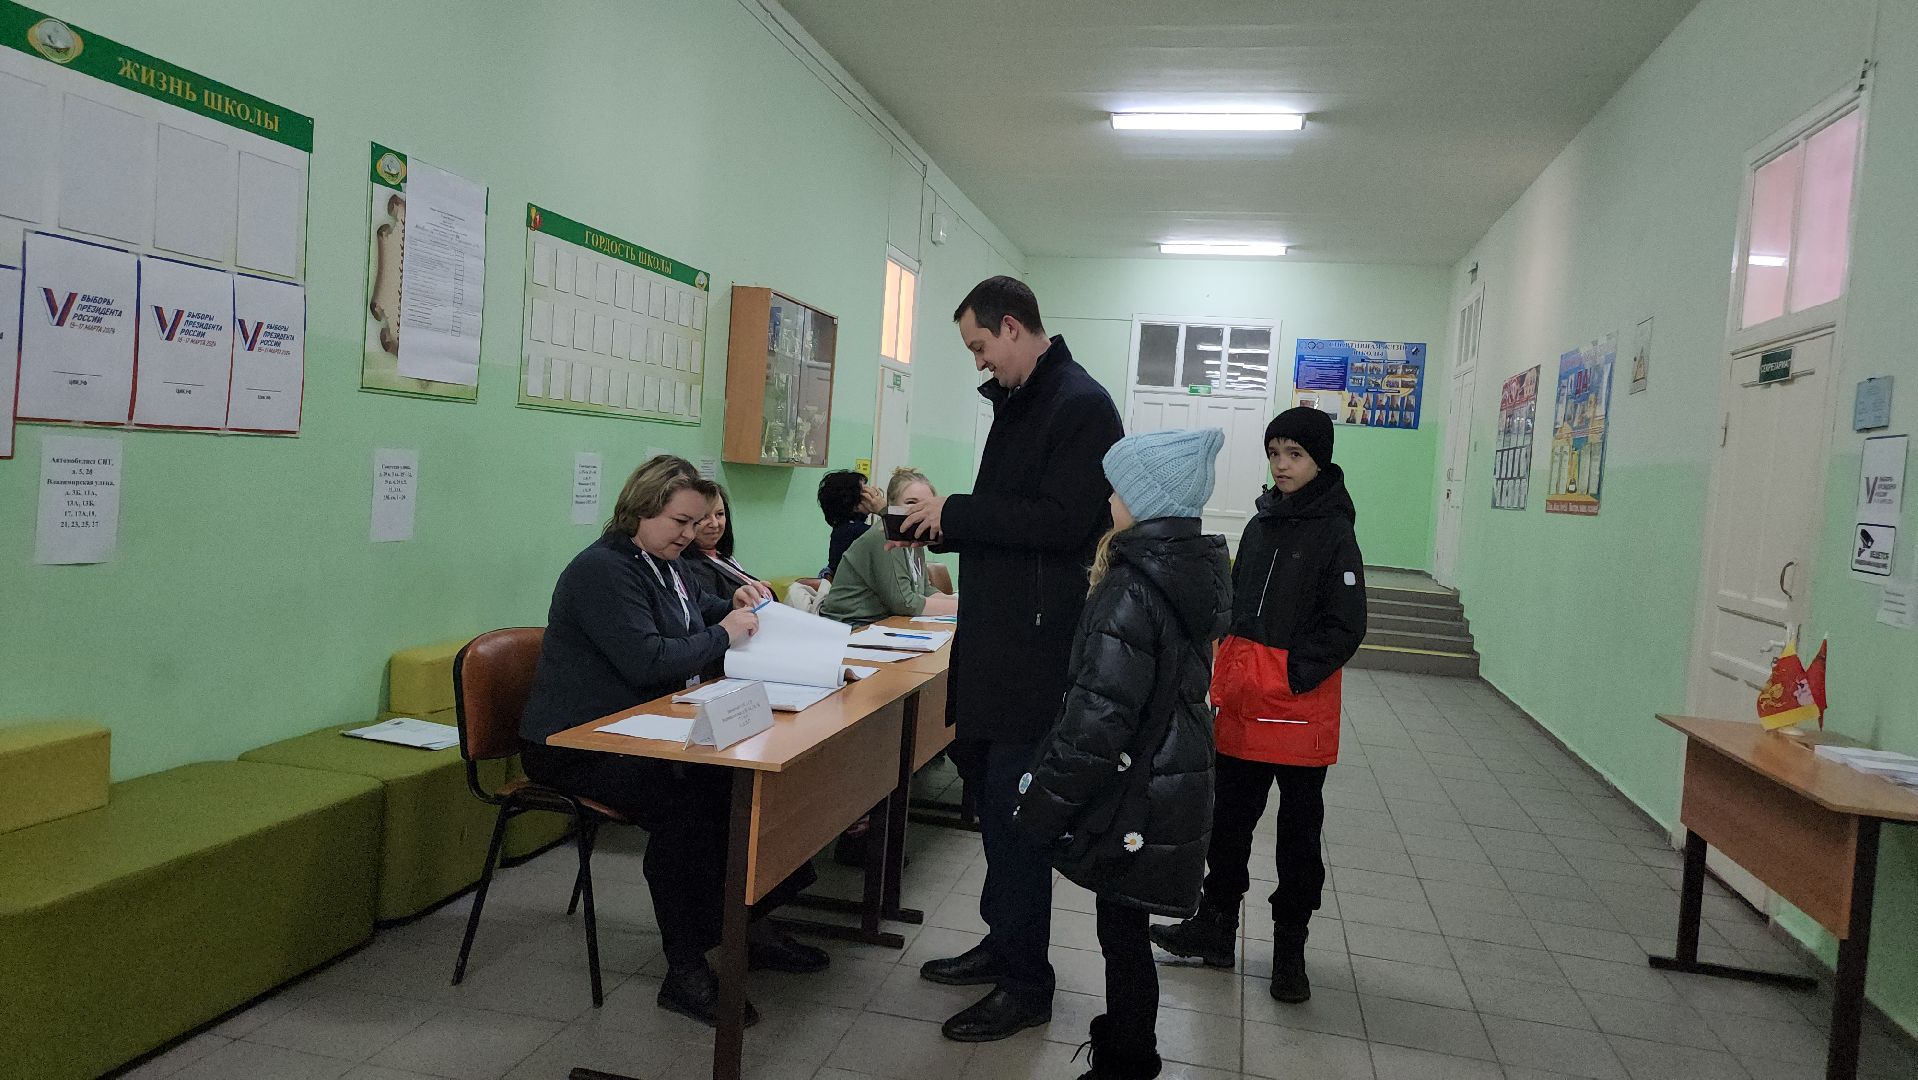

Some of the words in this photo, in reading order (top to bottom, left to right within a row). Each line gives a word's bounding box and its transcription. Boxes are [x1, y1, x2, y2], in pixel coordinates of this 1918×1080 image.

[117, 57, 197, 102] ЖИЗНЬ
[203, 89, 280, 133] ШКОЛЫ
[585, 230, 636, 261] ГОРДОСТЬ
[638, 250, 672, 275] ШКОЛЫ
[80, 294, 114, 305] ВЫБОРЫ
[77, 303, 122, 317] ПРЕЗИДЕНТА
[72, 313, 103, 324] РОССИИ
[187, 311, 214, 321] ВЫБОРЫ
[184, 320, 223, 332] ПРЕЗИДЕНТА
[180, 328, 206, 338] РОССИИ
